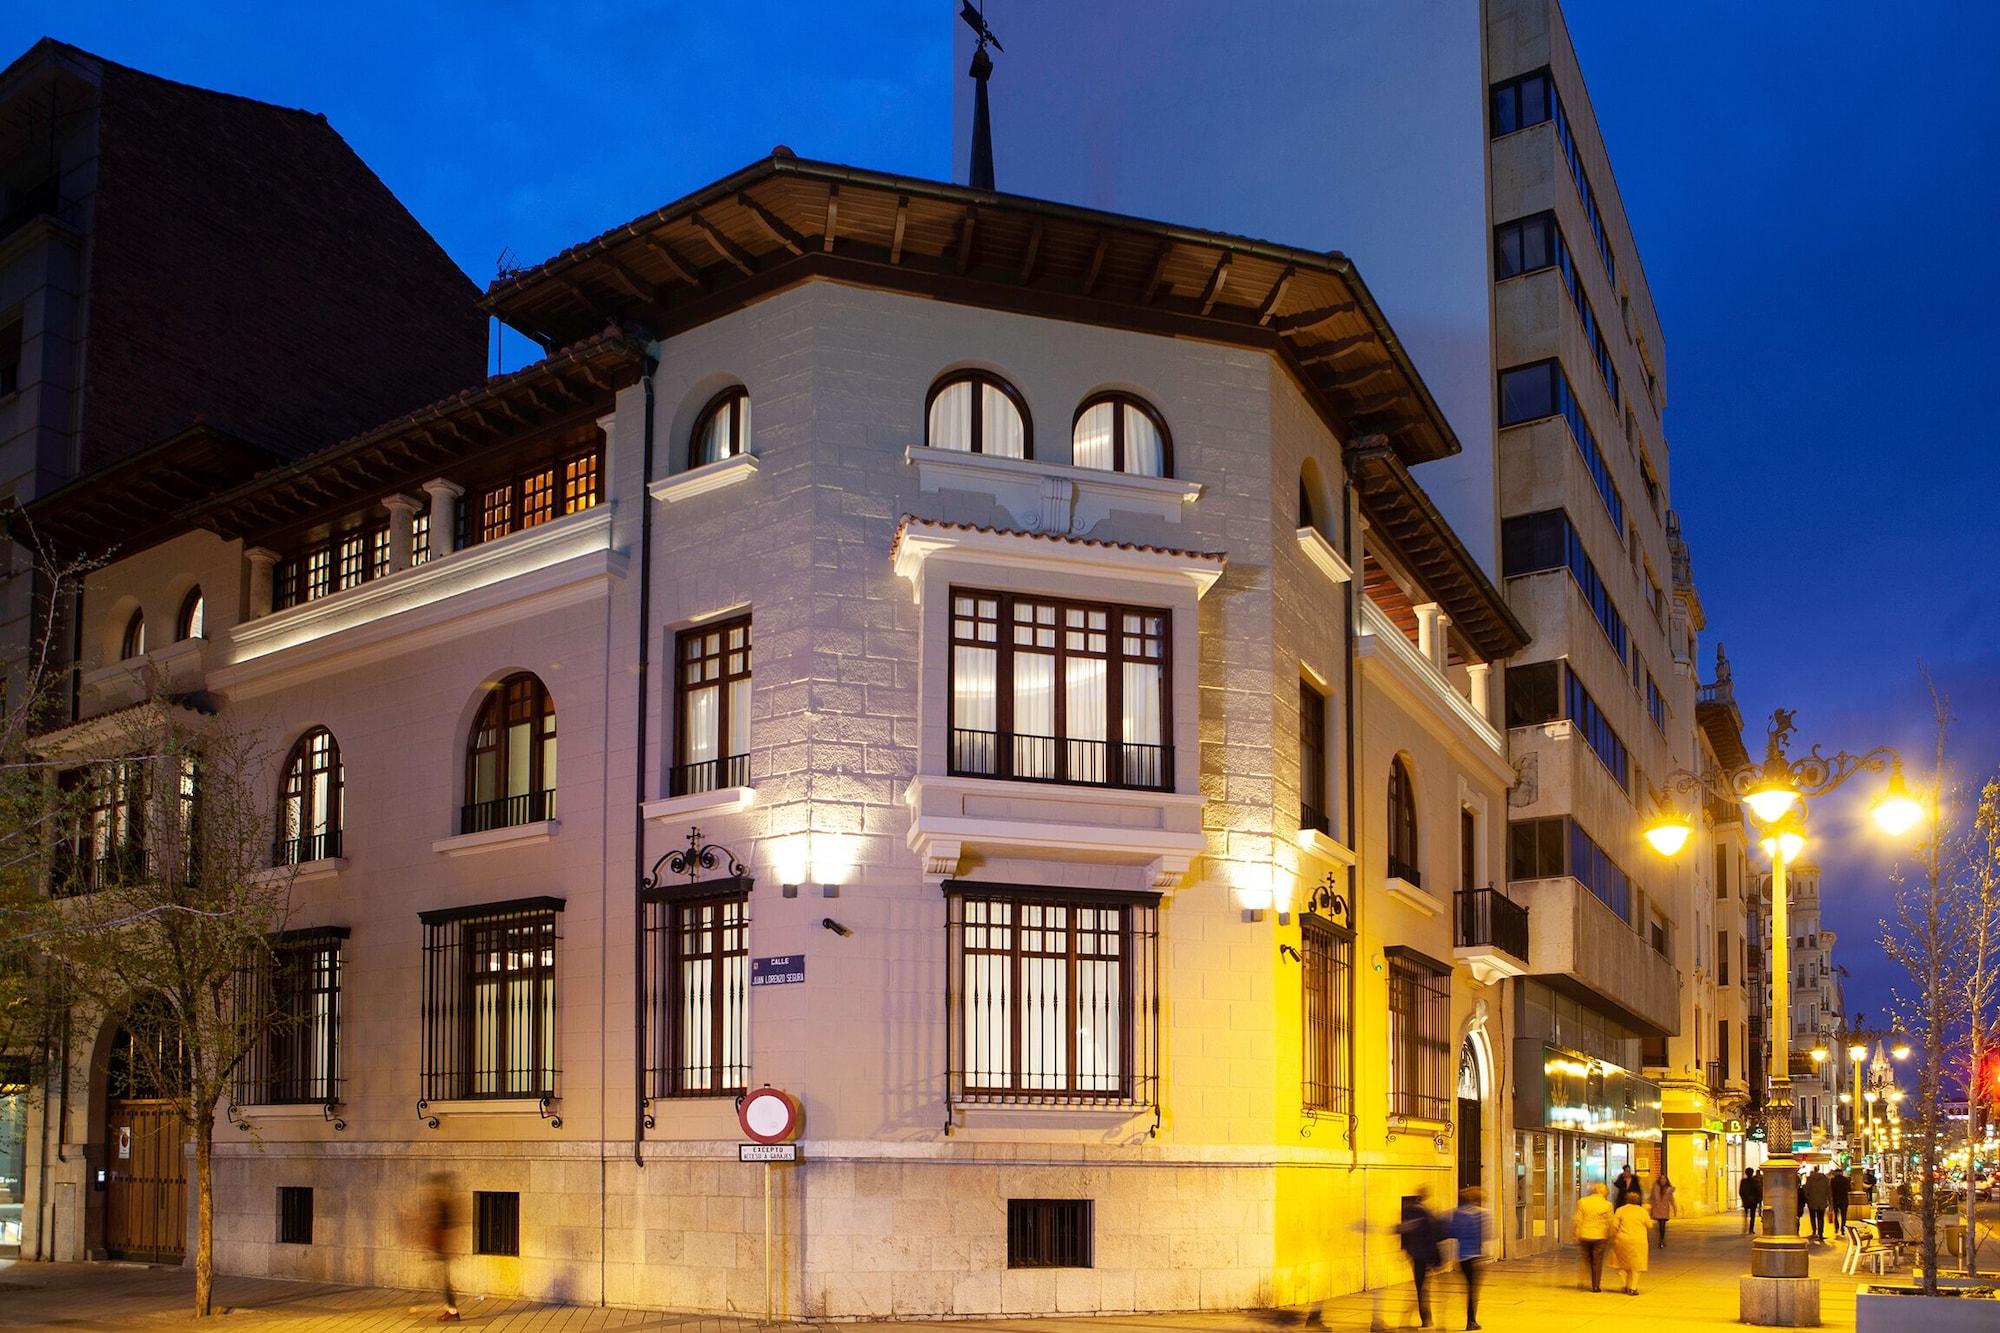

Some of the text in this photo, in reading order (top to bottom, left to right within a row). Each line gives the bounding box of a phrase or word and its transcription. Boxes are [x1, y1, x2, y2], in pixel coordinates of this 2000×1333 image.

[752, 973, 803, 984] JUAN LORENZO SEGURA
